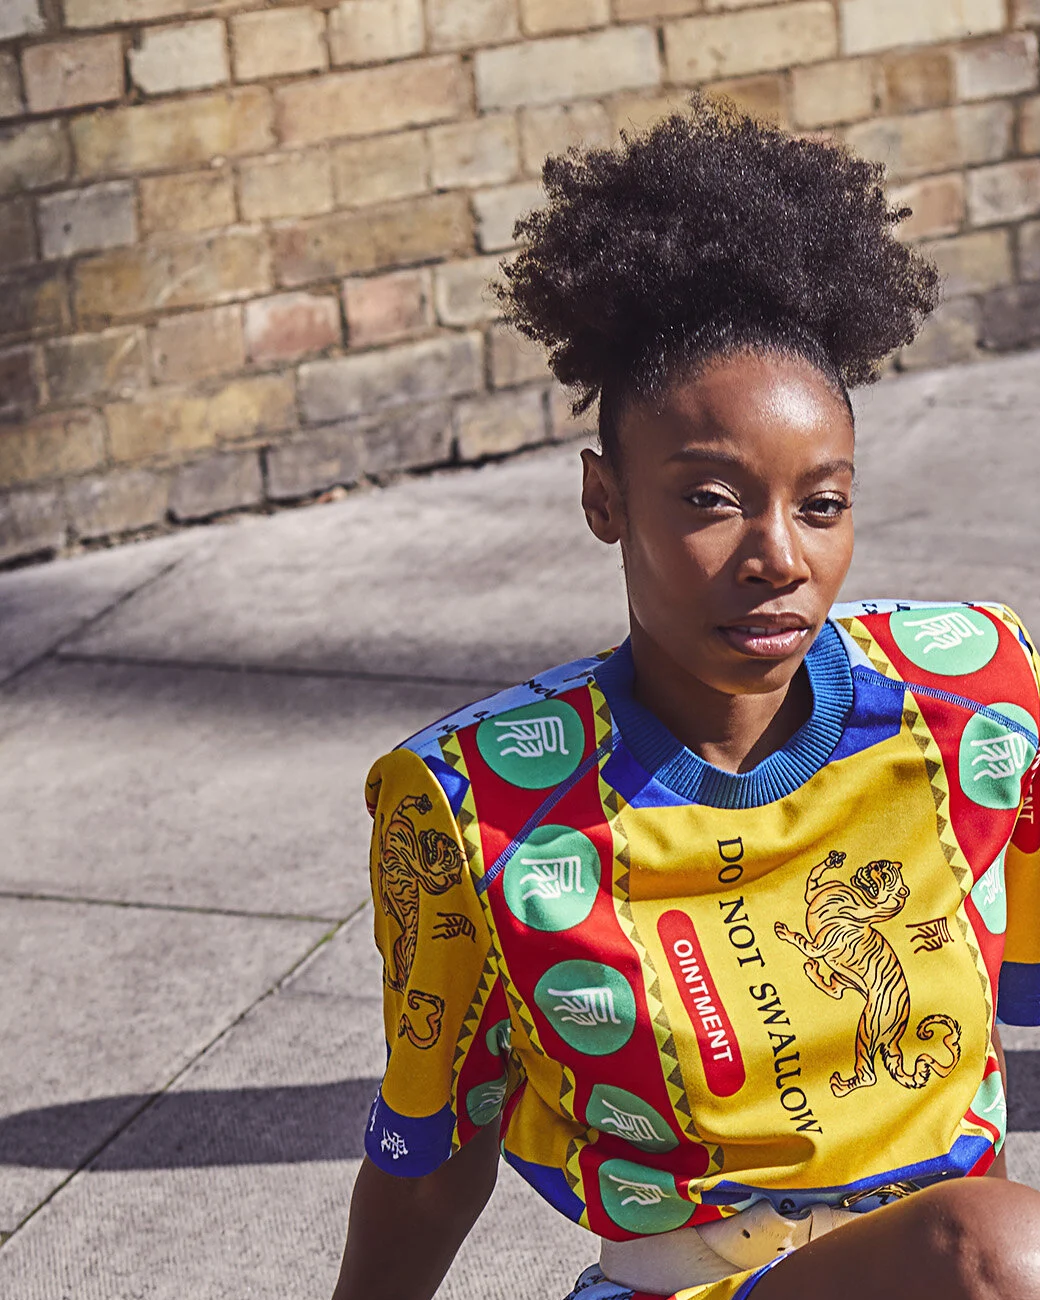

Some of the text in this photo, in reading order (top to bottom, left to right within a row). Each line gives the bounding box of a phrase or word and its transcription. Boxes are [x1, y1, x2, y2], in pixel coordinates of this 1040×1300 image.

[672, 938, 734, 1063] OINTMENT
[716, 836, 823, 1135] DO NOT SWALLOW
